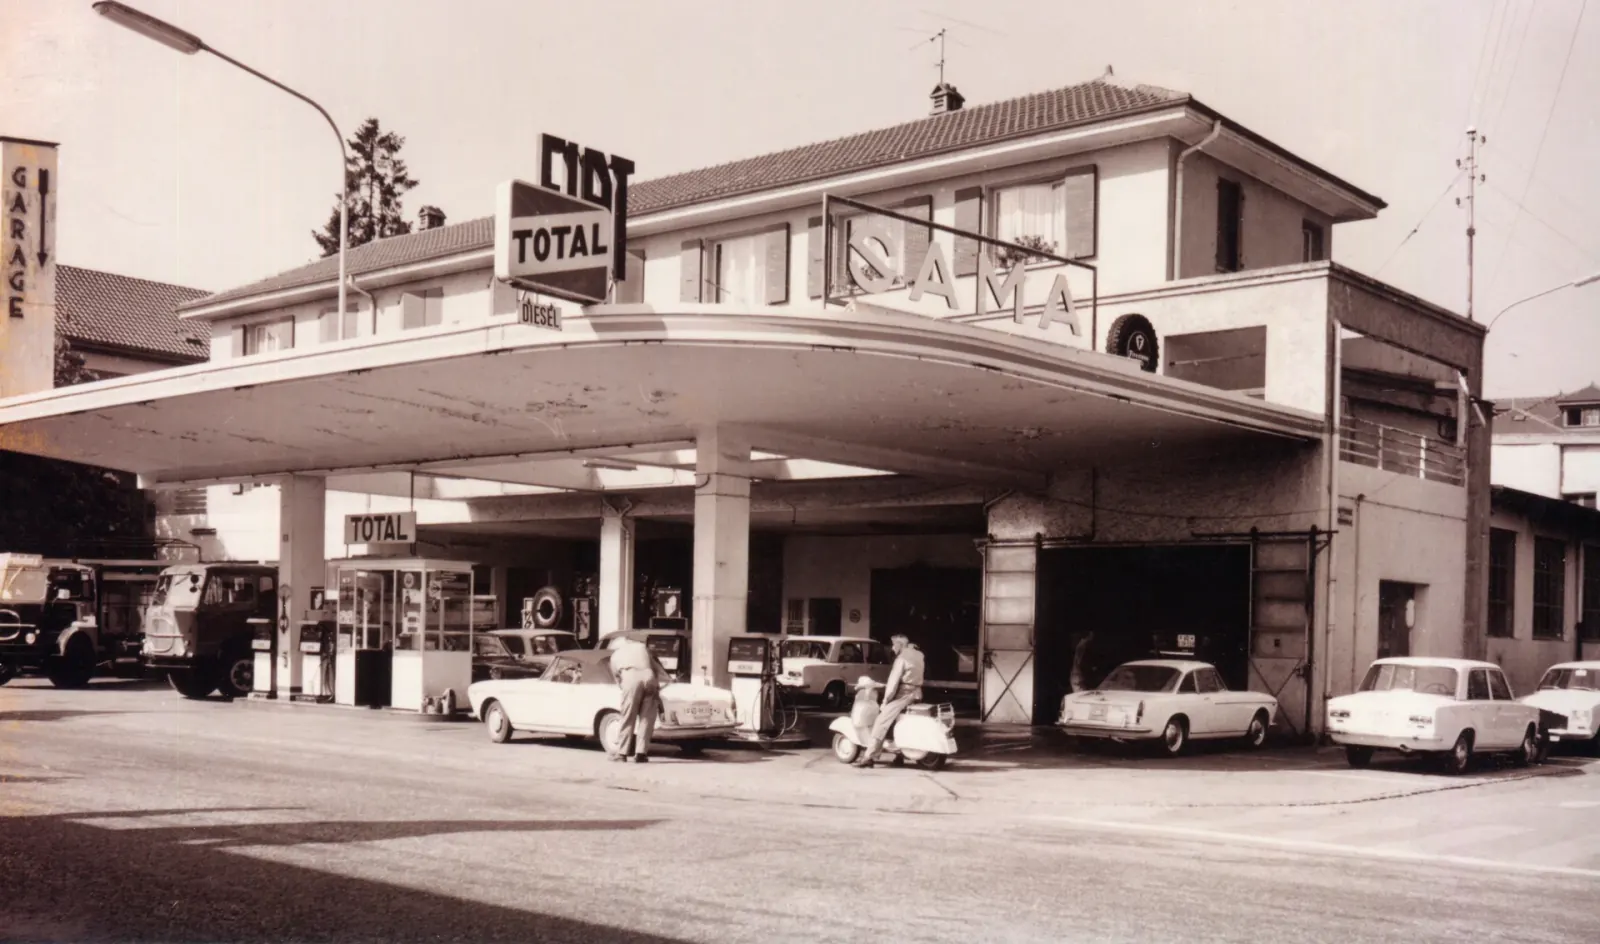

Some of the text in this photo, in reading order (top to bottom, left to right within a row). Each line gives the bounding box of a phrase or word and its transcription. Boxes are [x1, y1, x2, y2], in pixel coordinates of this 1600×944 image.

[9, 166, 27, 318] GARAGE
[512, 223, 608, 264] TOTAL
[848, 227, 1082, 336] SAMA
[522, 304, 560, 328] DIESEL
[350, 514, 407, 541] TOTAL
